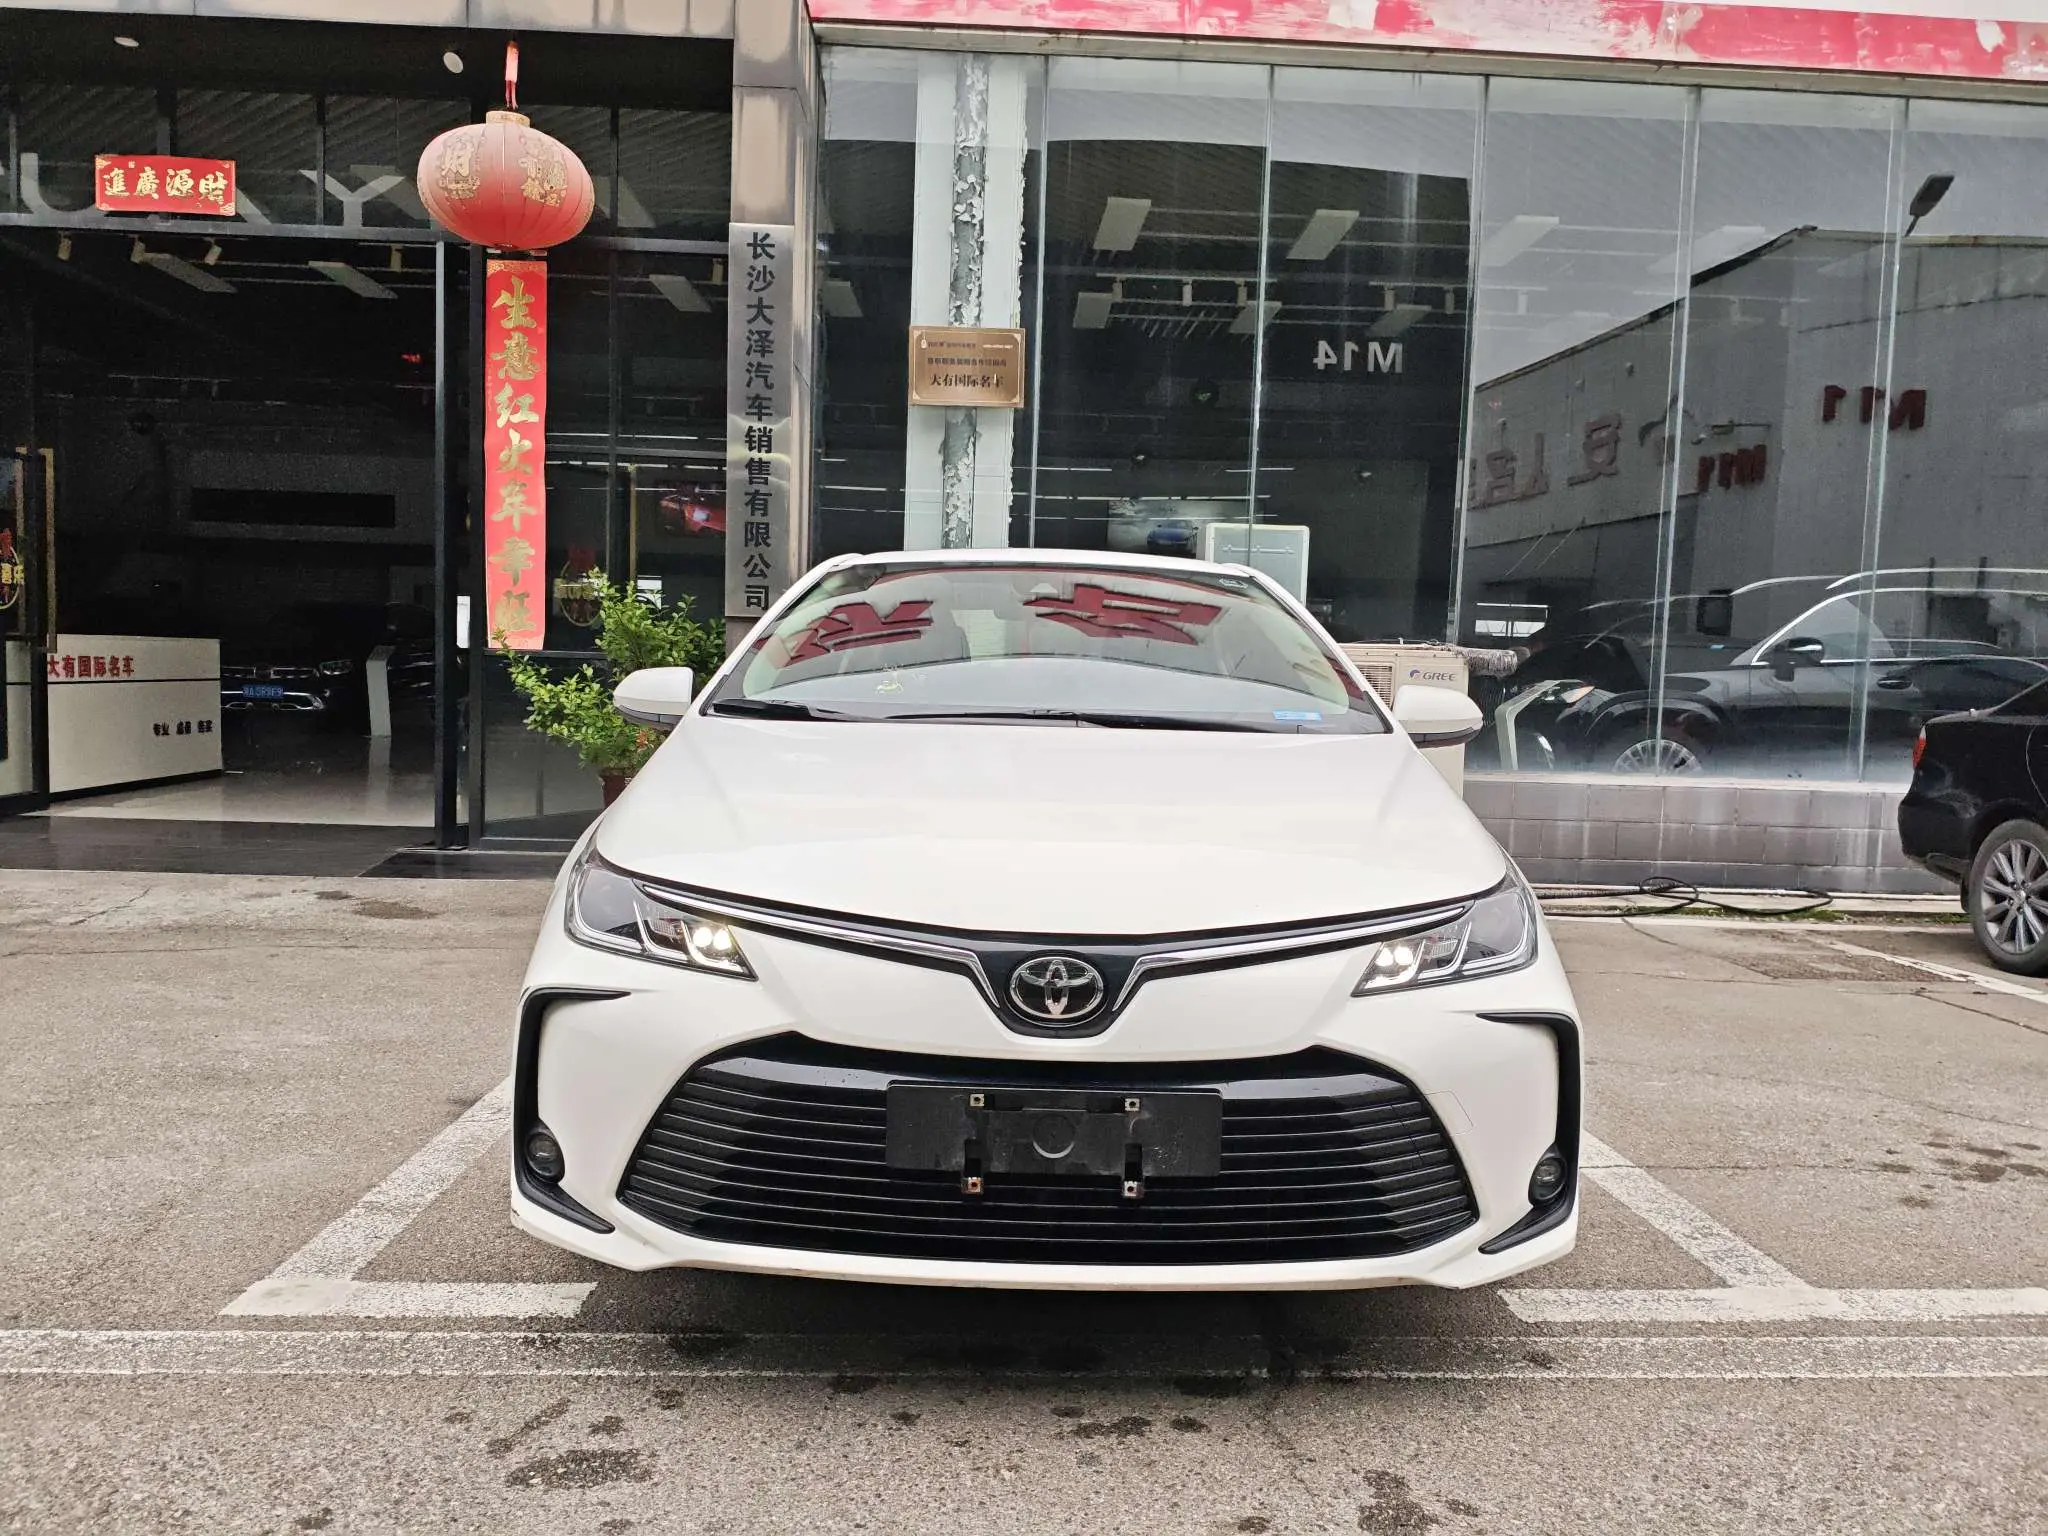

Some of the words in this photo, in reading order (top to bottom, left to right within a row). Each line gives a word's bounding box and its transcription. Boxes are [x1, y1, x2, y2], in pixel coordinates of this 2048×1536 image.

[743, 231, 776, 612] 长沙大泽汽车销售有限公司
[1423, 671, 1456, 681] GREE
